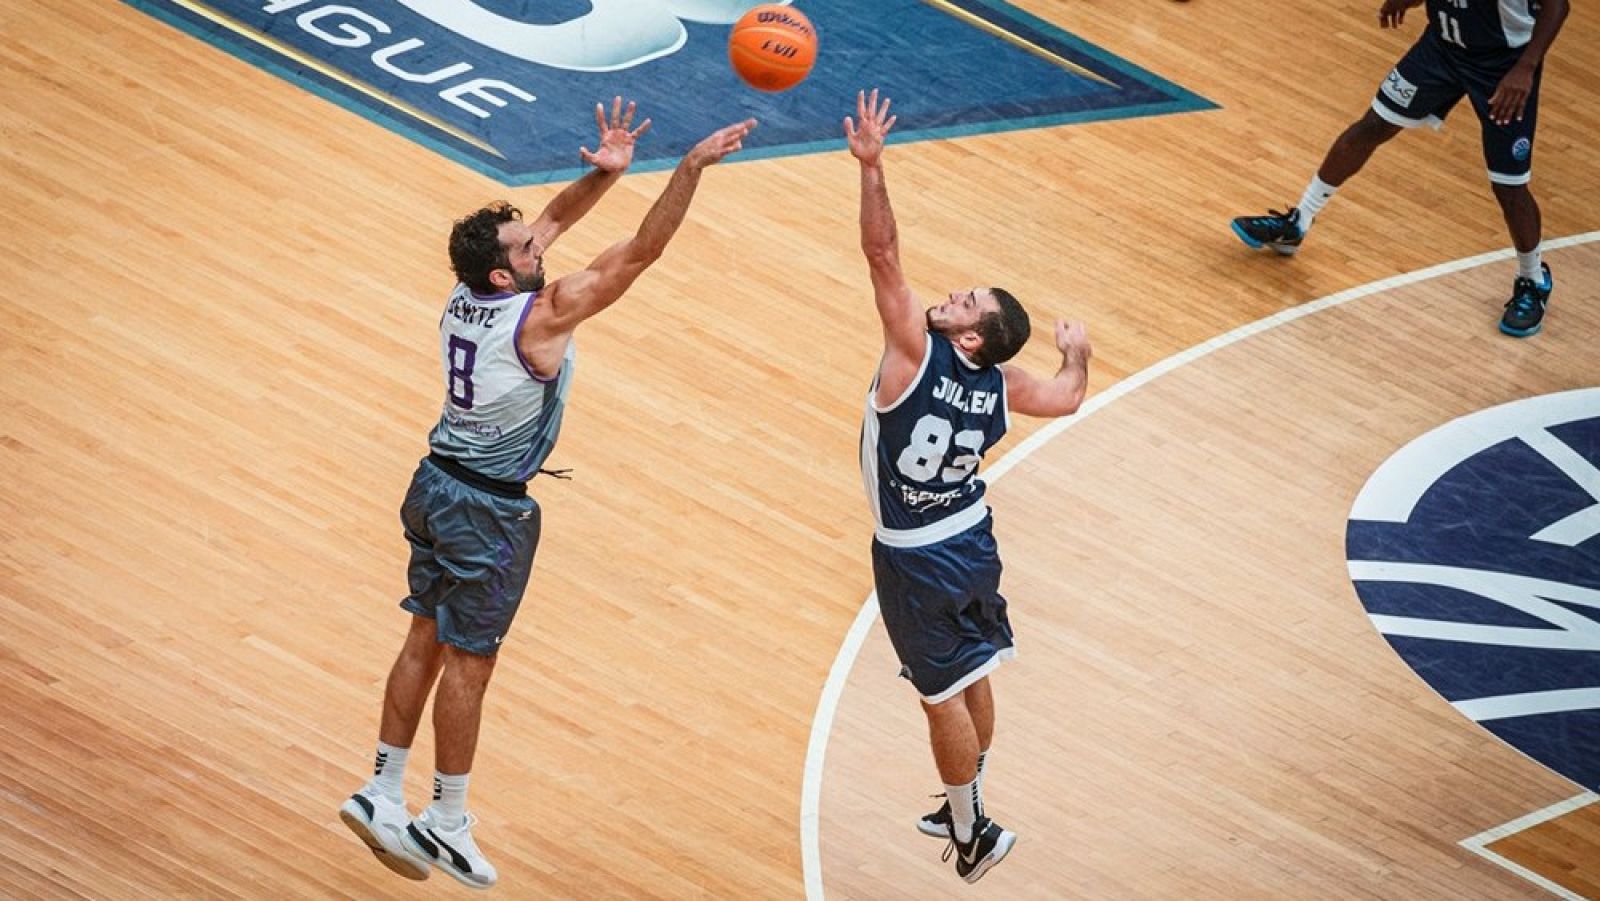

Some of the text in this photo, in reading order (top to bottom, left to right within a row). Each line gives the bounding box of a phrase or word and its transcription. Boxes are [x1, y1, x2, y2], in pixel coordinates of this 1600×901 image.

[263, 0, 537, 119] GUE
[1438, 11, 1467, 49] 11
[448, 334, 477, 410] 8
[896, 414, 985, 483] 83
